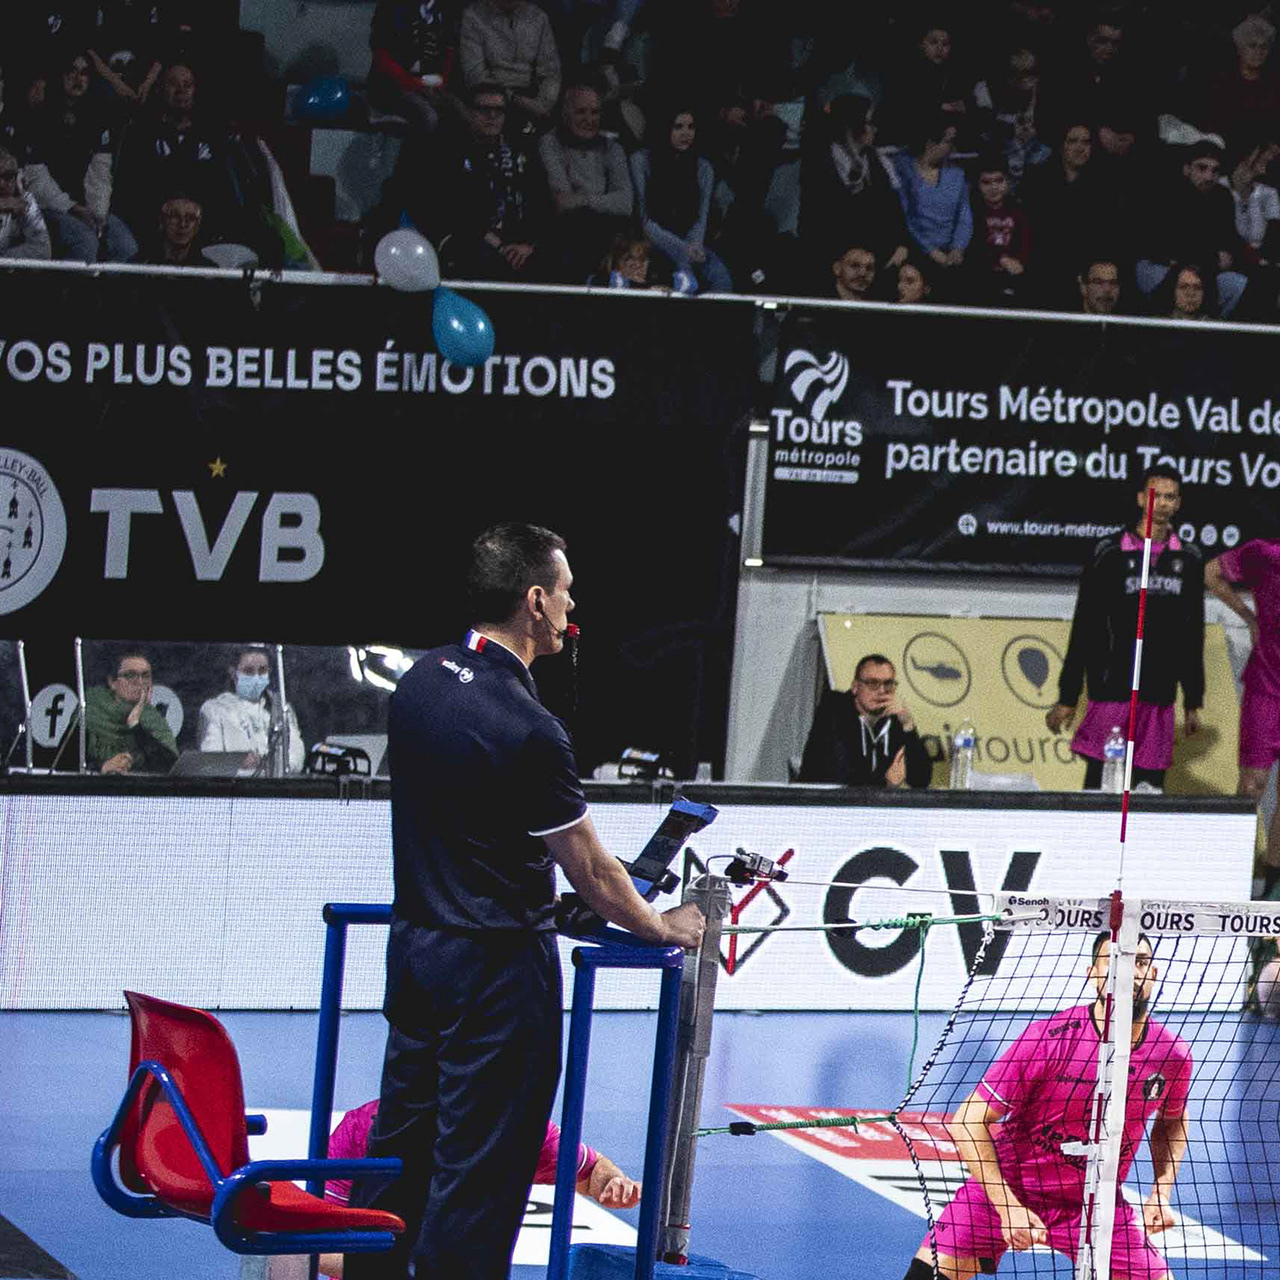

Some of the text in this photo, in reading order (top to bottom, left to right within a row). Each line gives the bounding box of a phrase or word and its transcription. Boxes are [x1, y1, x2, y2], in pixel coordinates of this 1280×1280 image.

[0, 339, 615, 399] OS PLUS BELLES ÉMOTIONS
[771, 409, 863, 447] Tours
[886, 380, 989, 420] Tours
[999, 385, 1181, 434] Métropole
[1187, 396, 1241, 433] Val
[775, 449, 861, 468] métropole
[885, 439, 1077, 479] partenaire
[1085, 443, 1128, 480] du
[90, 488, 326, 584] TVB
[824, 847, 1043, 979] CV
[1017, 898, 1050, 906] Senoh
